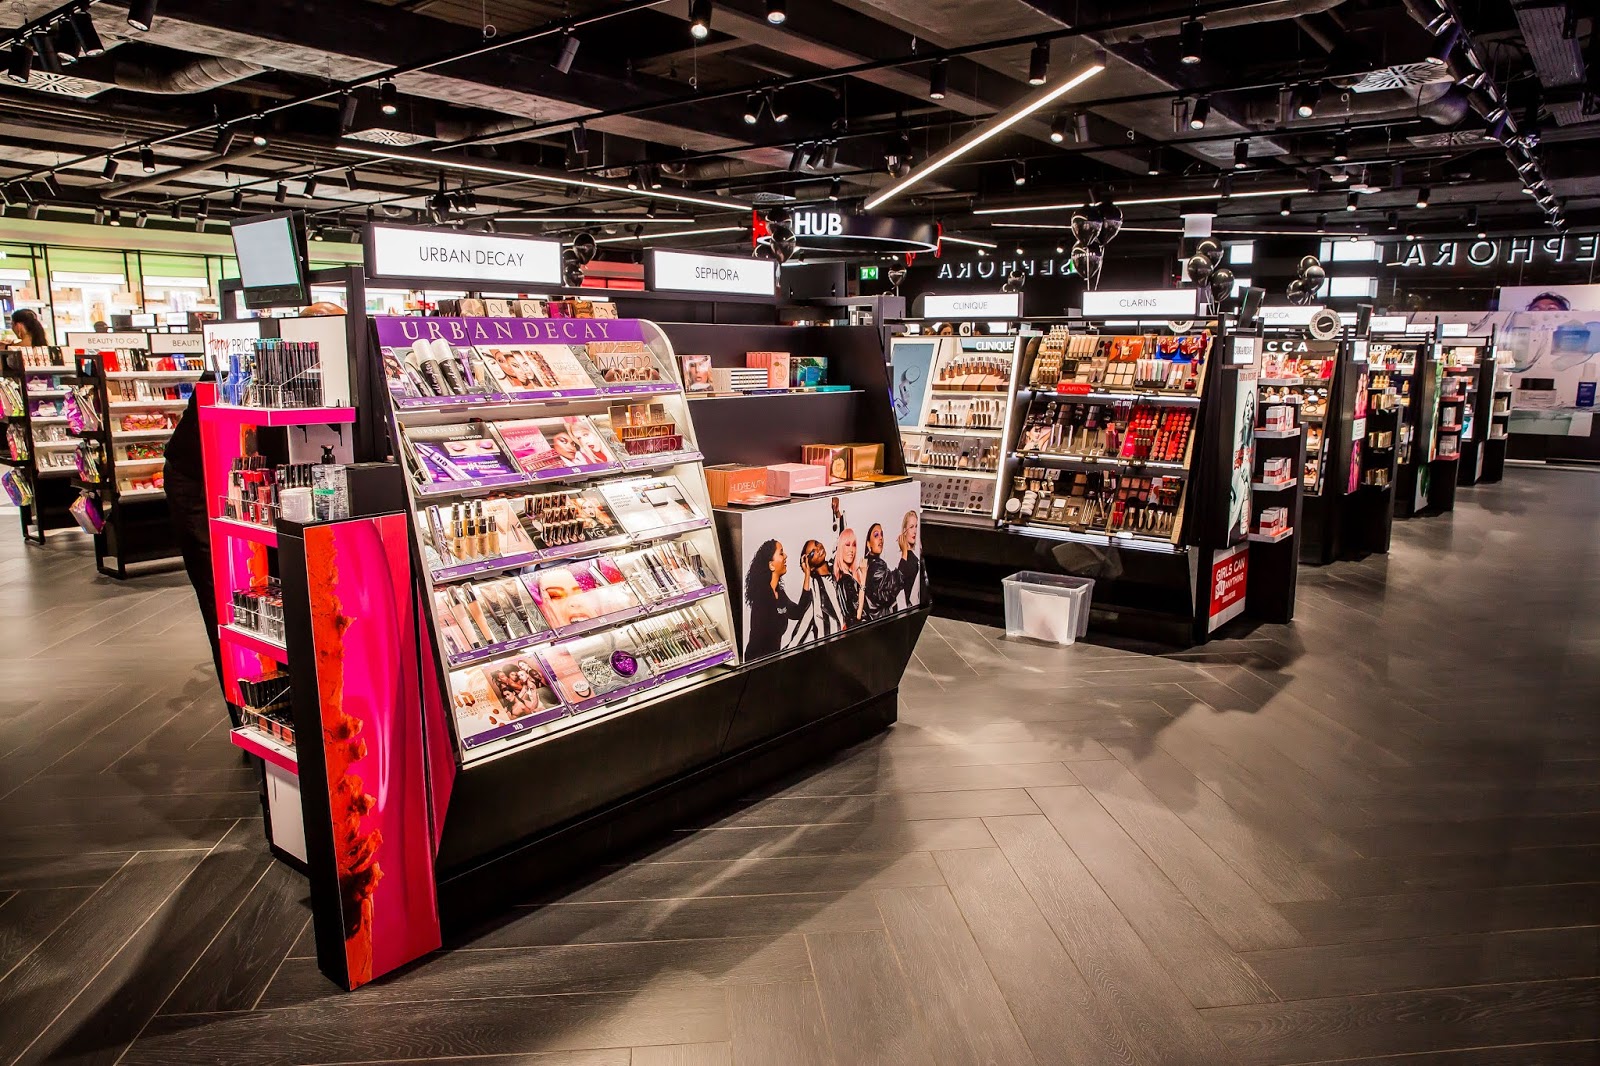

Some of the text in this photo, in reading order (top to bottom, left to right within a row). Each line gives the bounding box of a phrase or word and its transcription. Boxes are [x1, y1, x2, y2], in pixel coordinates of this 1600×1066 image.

[795, 212, 843, 236] HUB
[419, 246, 525, 268] URBAN DECAY
[694, 265, 740, 282] SEPHORA
[952, 300, 989, 311] CLINIQUE
[1119, 298, 1157, 308] CLARINS
[87, 337, 114, 345] BEAUTY
[399, 321, 610, 346] URBAN DECAY
[172, 339, 200, 347] BEAUTY
[208, 332, 257, 363] Happy PRICE
[975, 340, 1015, 352] CLINIQUE
[1216, 557, 1246, 582] GIRLS CAN
[1224, 572, 1244, 589] ANYTHING
